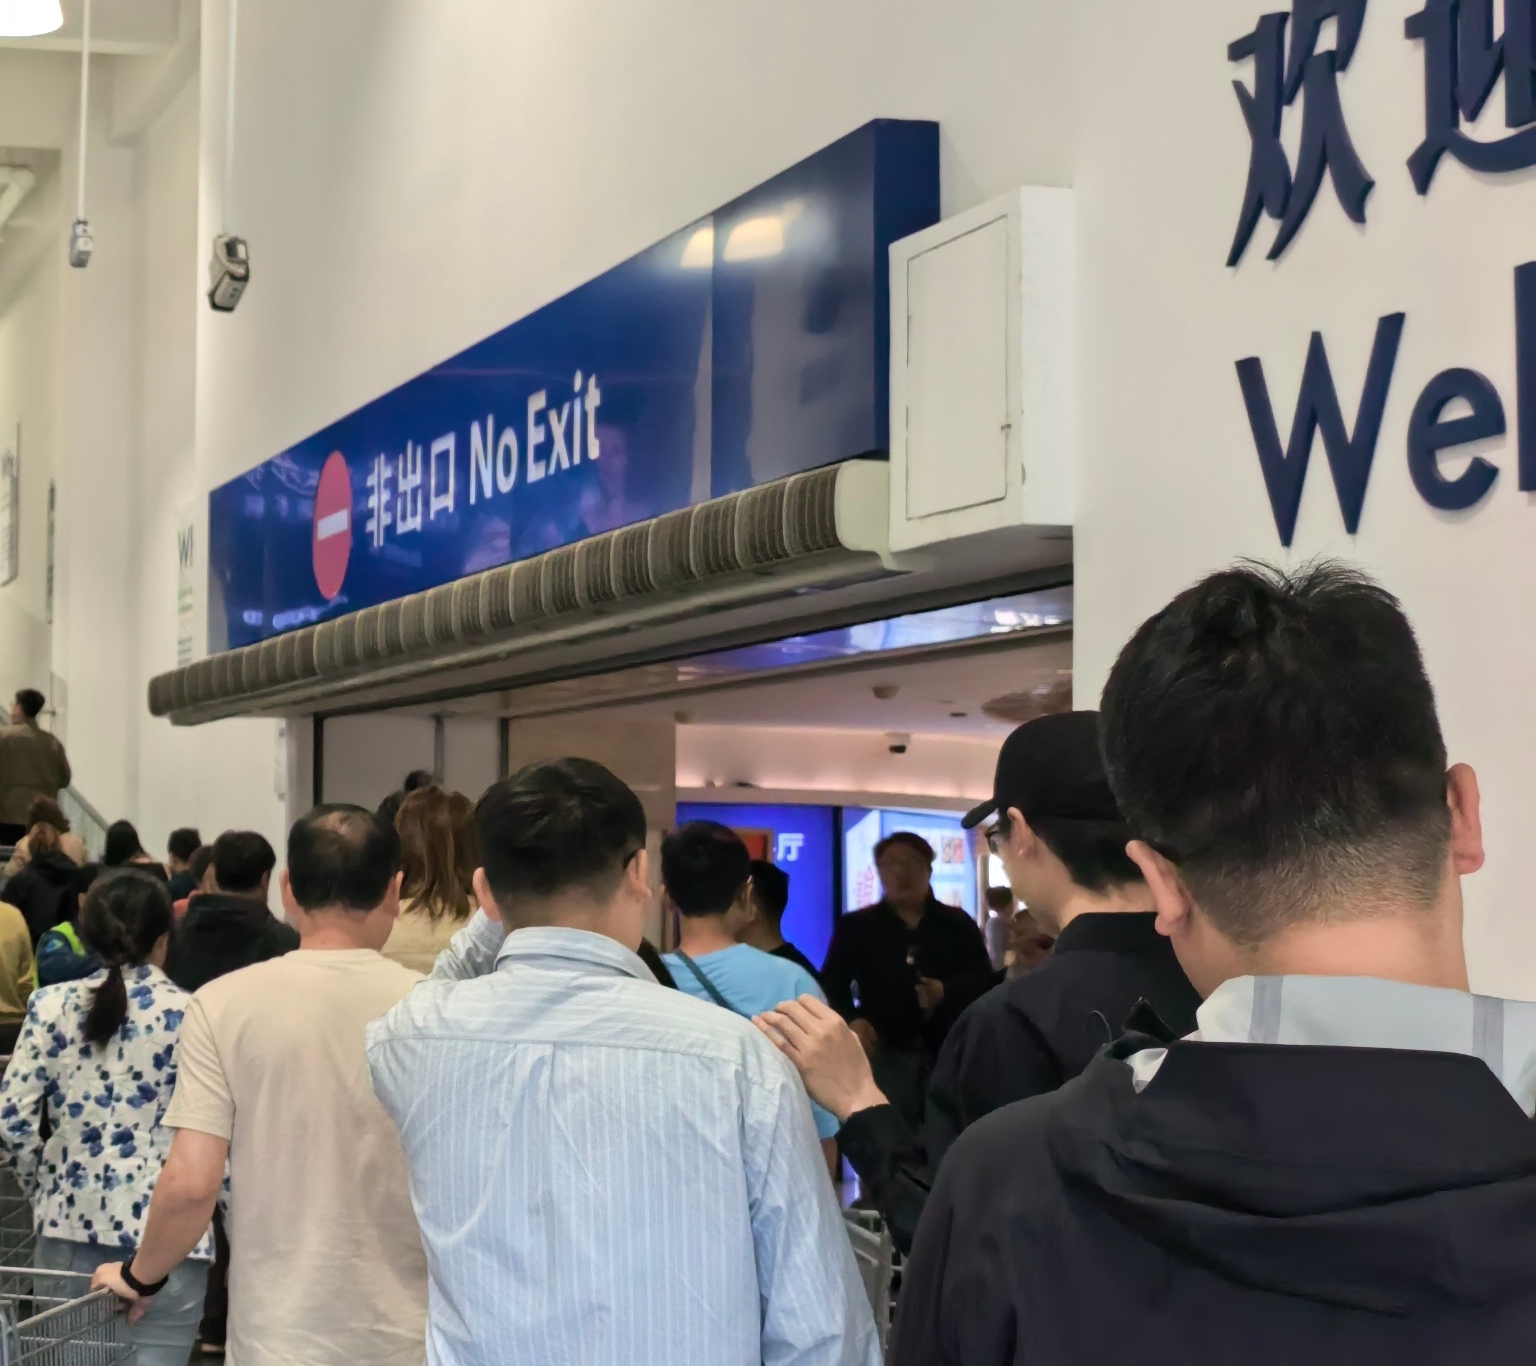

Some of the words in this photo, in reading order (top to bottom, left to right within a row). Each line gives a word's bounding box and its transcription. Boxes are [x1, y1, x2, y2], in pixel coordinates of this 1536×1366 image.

[365, 430, 456, 548] 非出口
[469, 412, 518, 505] No
[526, 369, 601, 484] Exit
[775, 832, 805, 862] 厅
